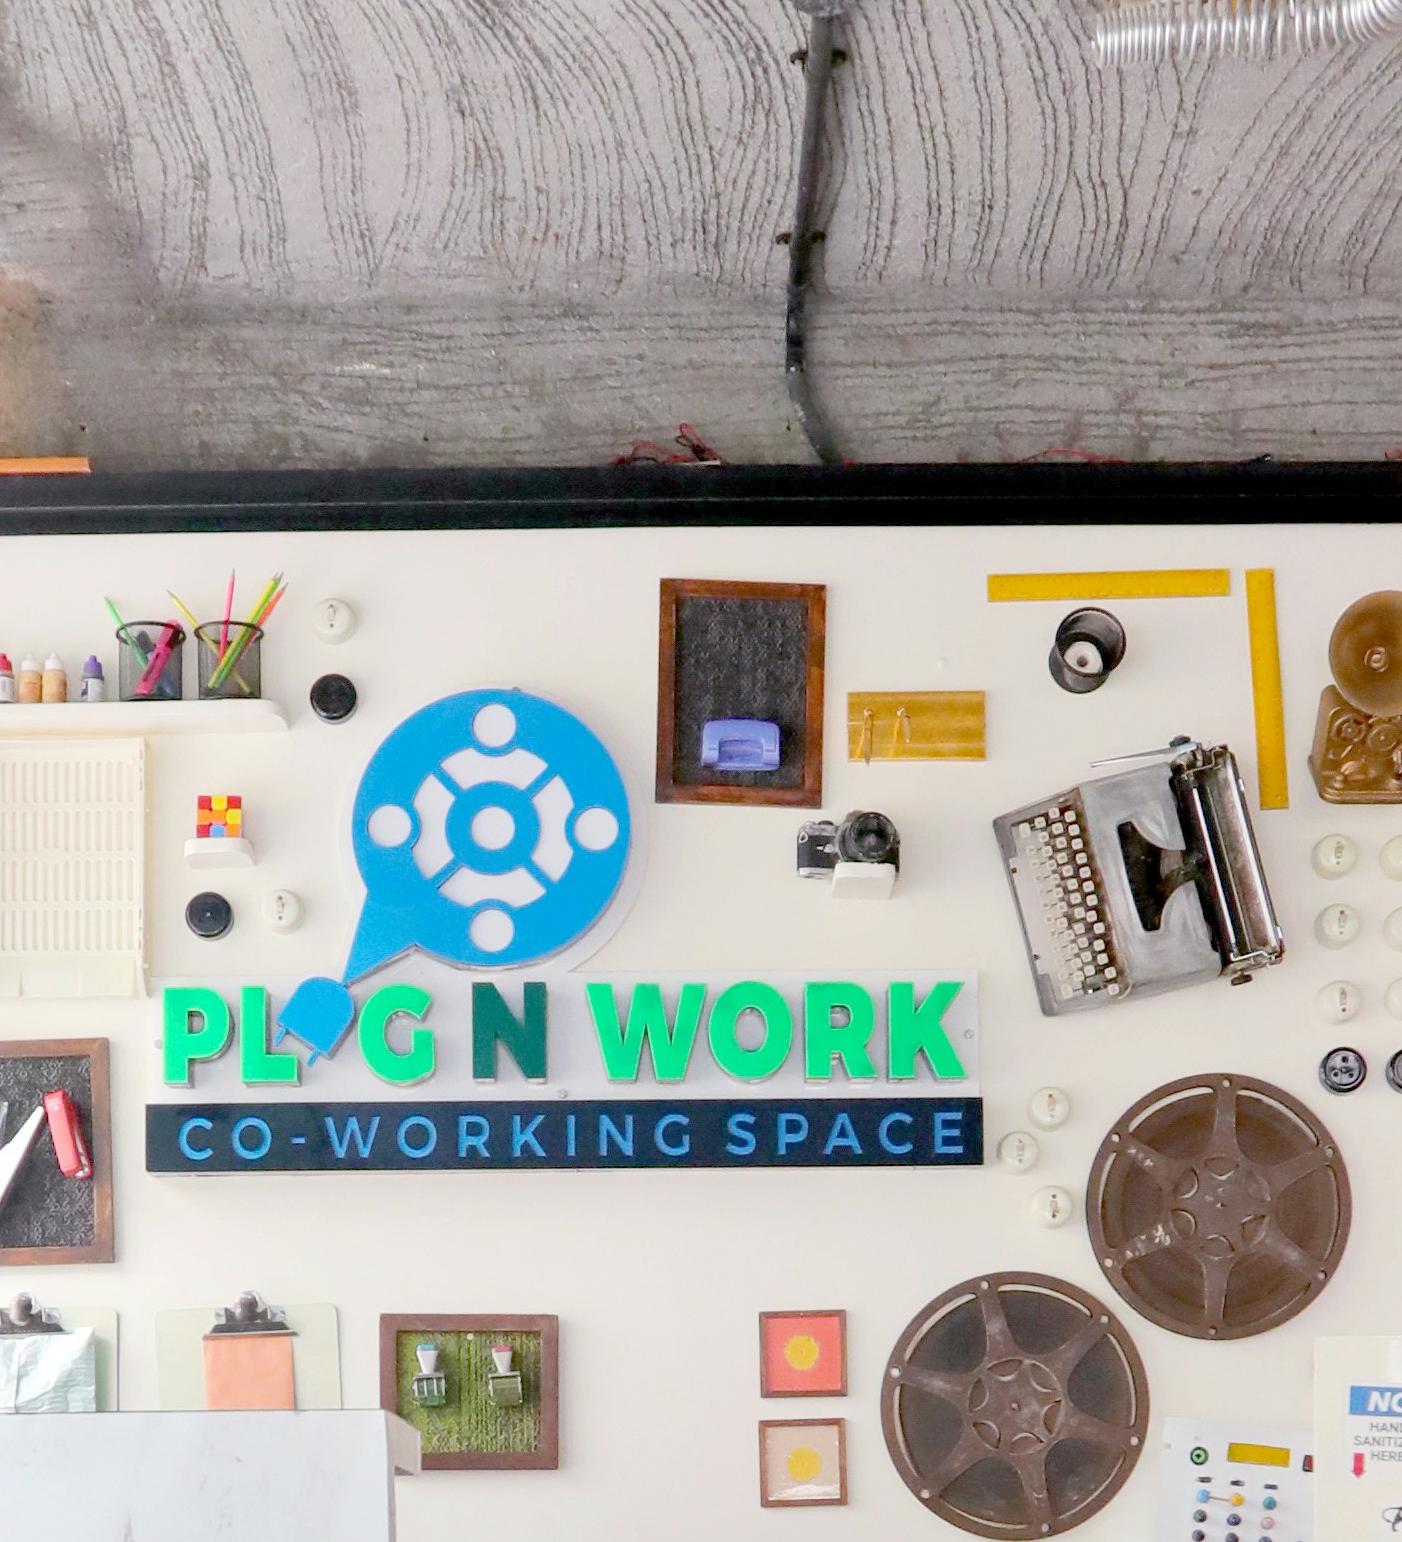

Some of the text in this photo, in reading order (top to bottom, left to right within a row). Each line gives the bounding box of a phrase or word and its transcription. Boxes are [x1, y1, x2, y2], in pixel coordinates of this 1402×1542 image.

[471, 981, 548, 1084] N
[585, 980, 969, 1084] WORK
[177, 1110, 965, 1160] CO-WORKING SPACE
